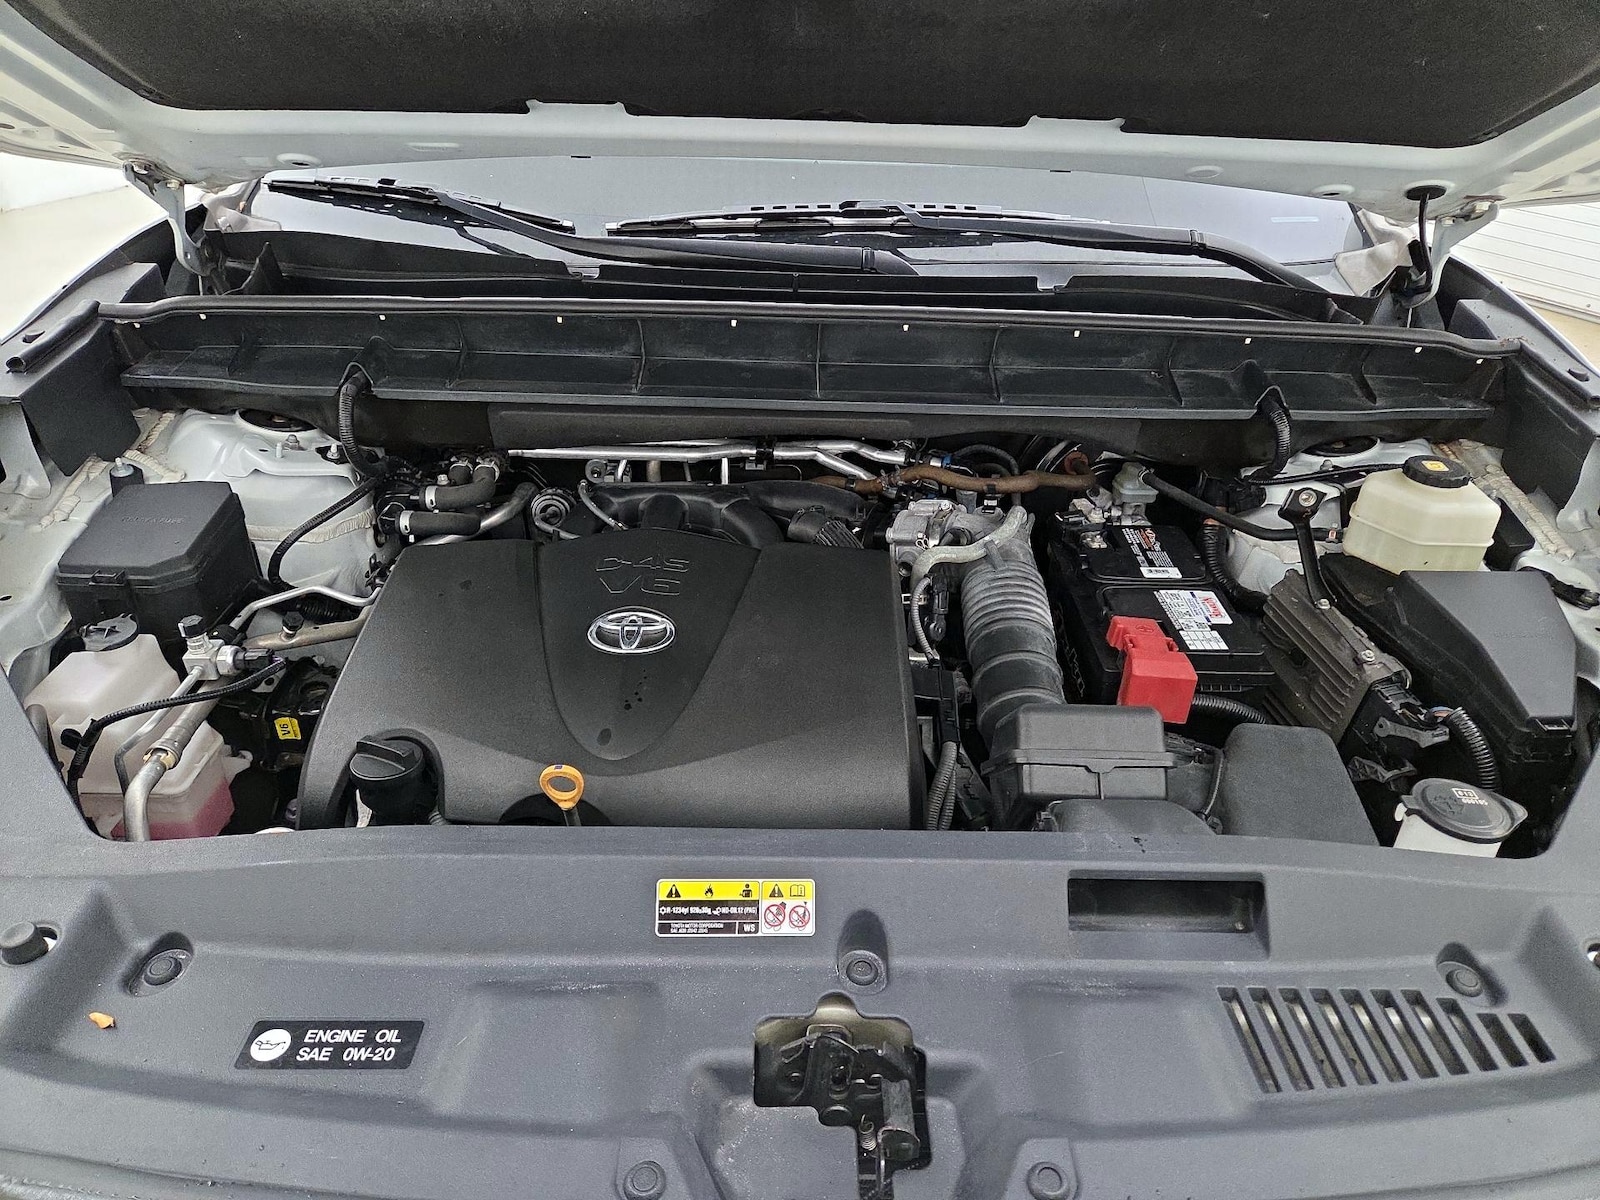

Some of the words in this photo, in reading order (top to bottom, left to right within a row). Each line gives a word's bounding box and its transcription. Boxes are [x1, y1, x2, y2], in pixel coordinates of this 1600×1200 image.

[595, 557, 690, 573] D-4S
[599, 574, 681, 596] V6
[279, 723, 291, 736] V6
[743, 923, 756, 933] WS
[303, 1029, 367, 1043] ENGINE
[375, 1029, 402, 1043] OIL
[296, 1047, 334, 1062] SAE
[342, 1047, 396, 1062] 0W-20
